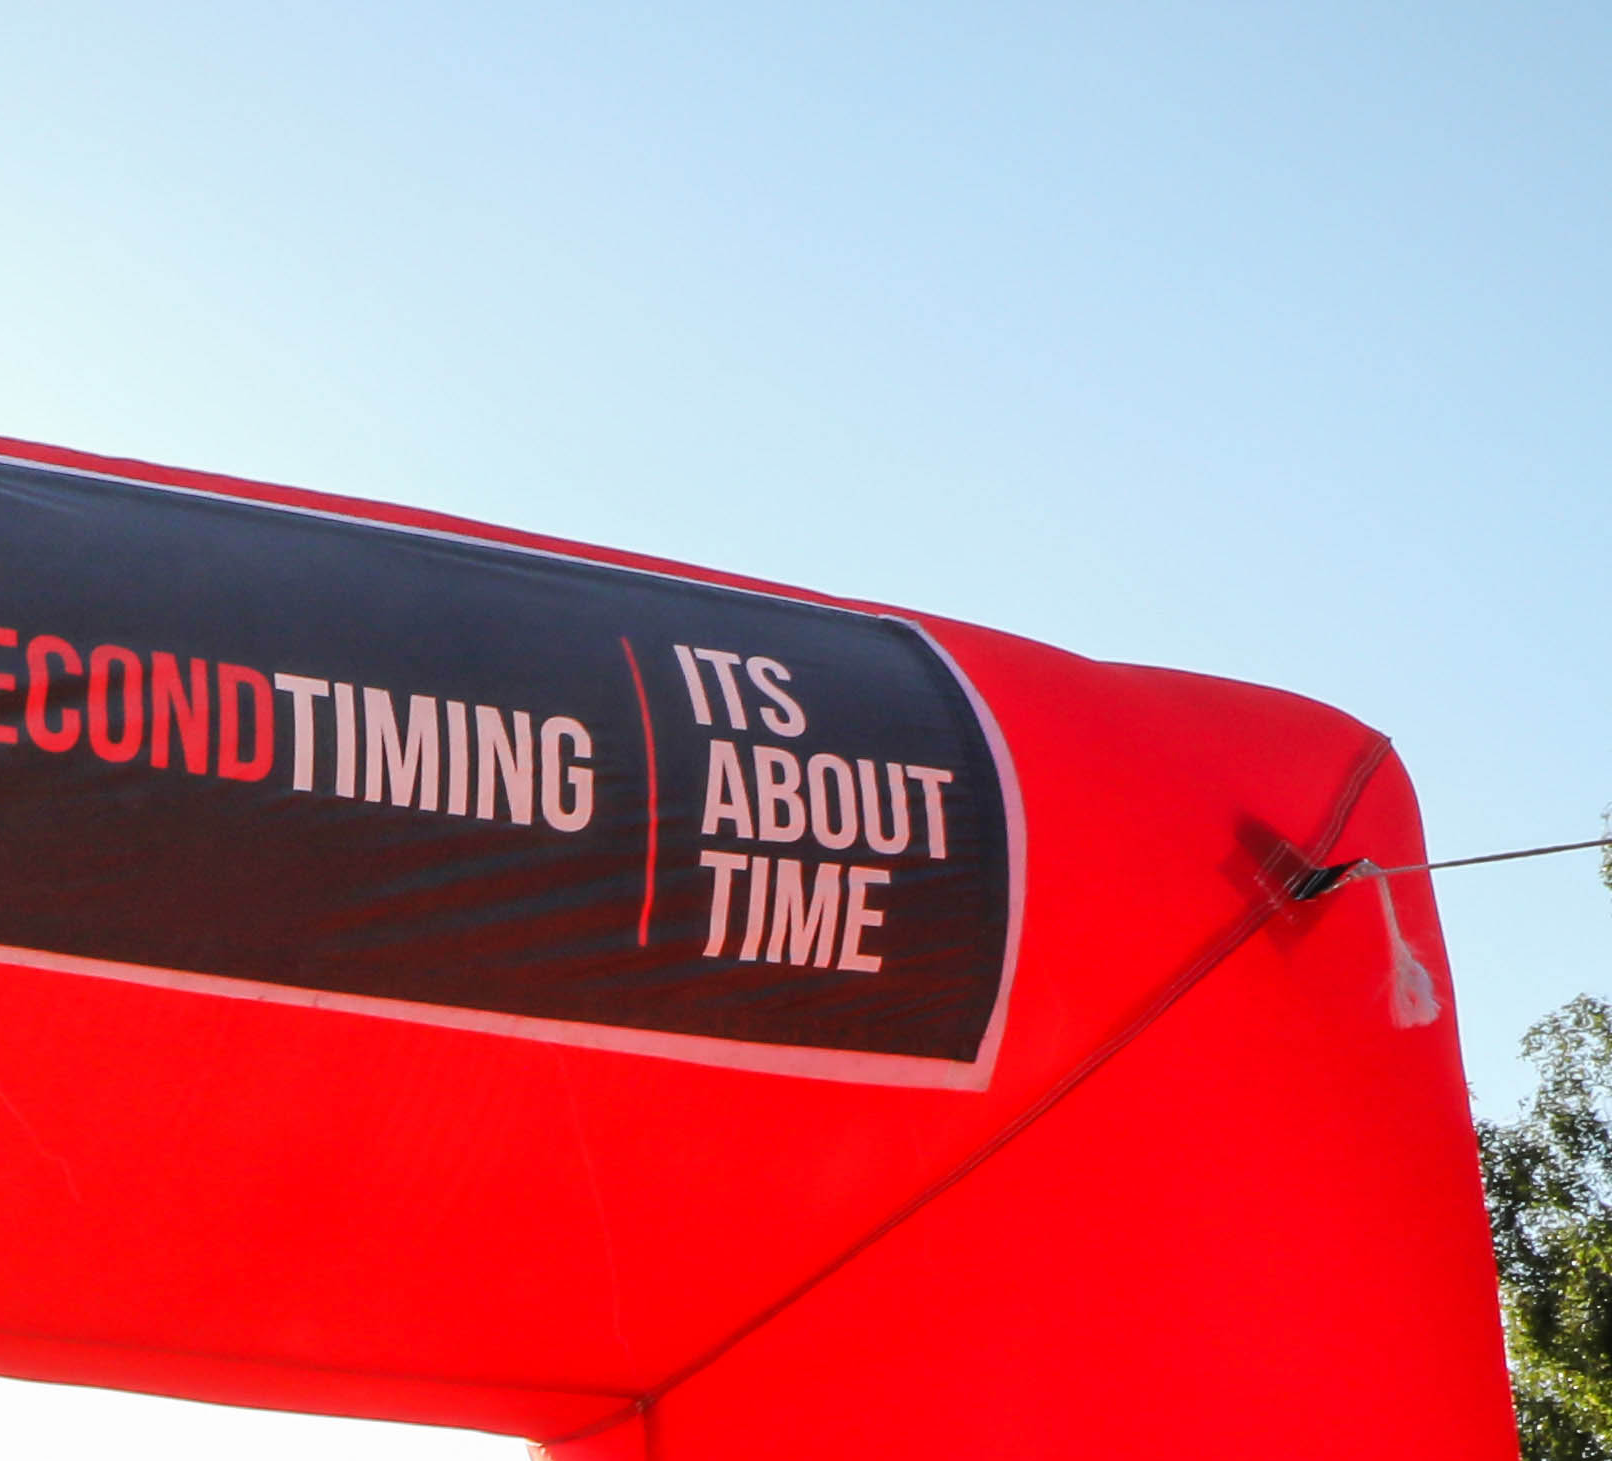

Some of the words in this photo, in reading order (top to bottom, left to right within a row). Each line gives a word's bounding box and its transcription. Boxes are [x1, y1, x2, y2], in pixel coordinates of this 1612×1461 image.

[673, 642, 805, 738] ITS
[700, 740, 953, 861] ABOUT
[700, 852, 888, 977] TIME
